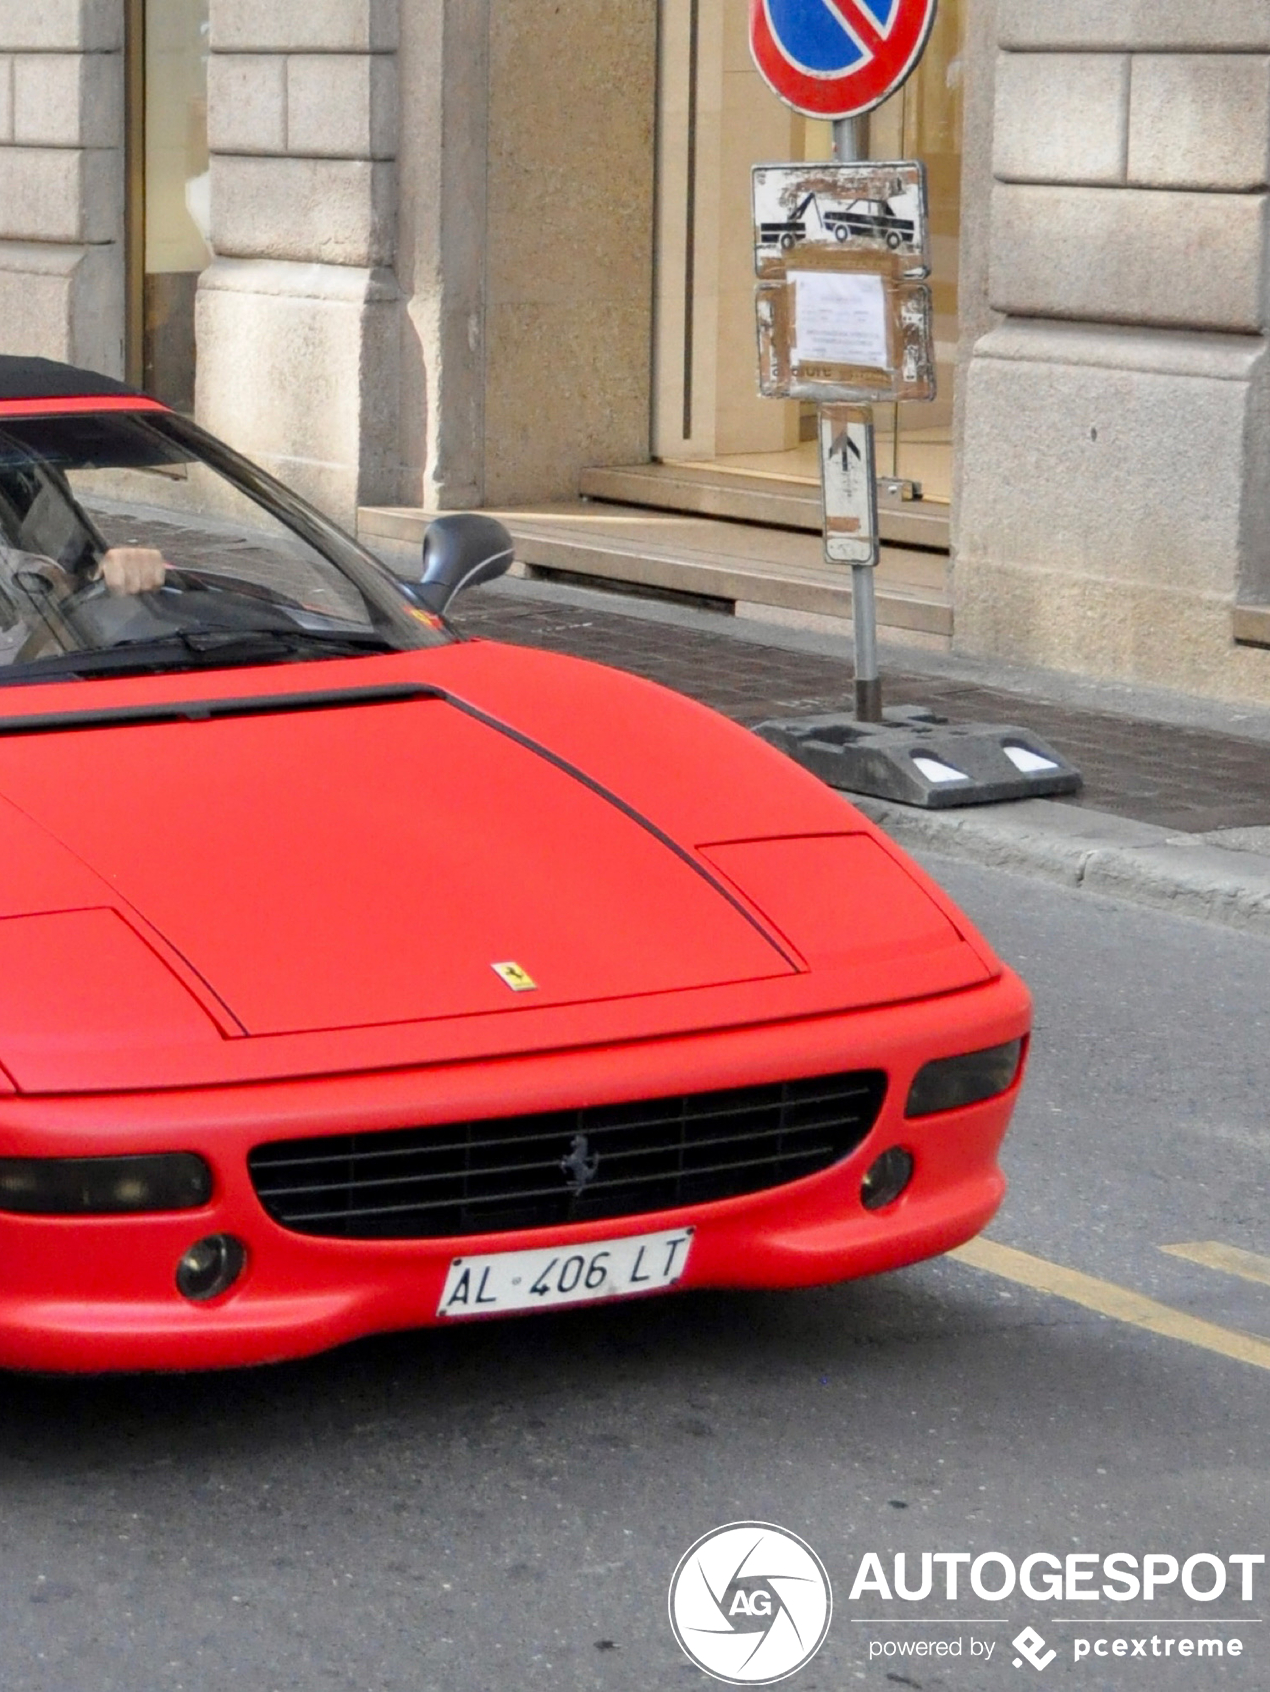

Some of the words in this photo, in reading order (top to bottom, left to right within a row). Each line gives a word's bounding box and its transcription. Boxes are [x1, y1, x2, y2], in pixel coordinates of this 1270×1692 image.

[447, 1266, 497, 1306] AL
[529, 1252, 610, 1296] 406
[630, 1238, 686, 1283] LT
